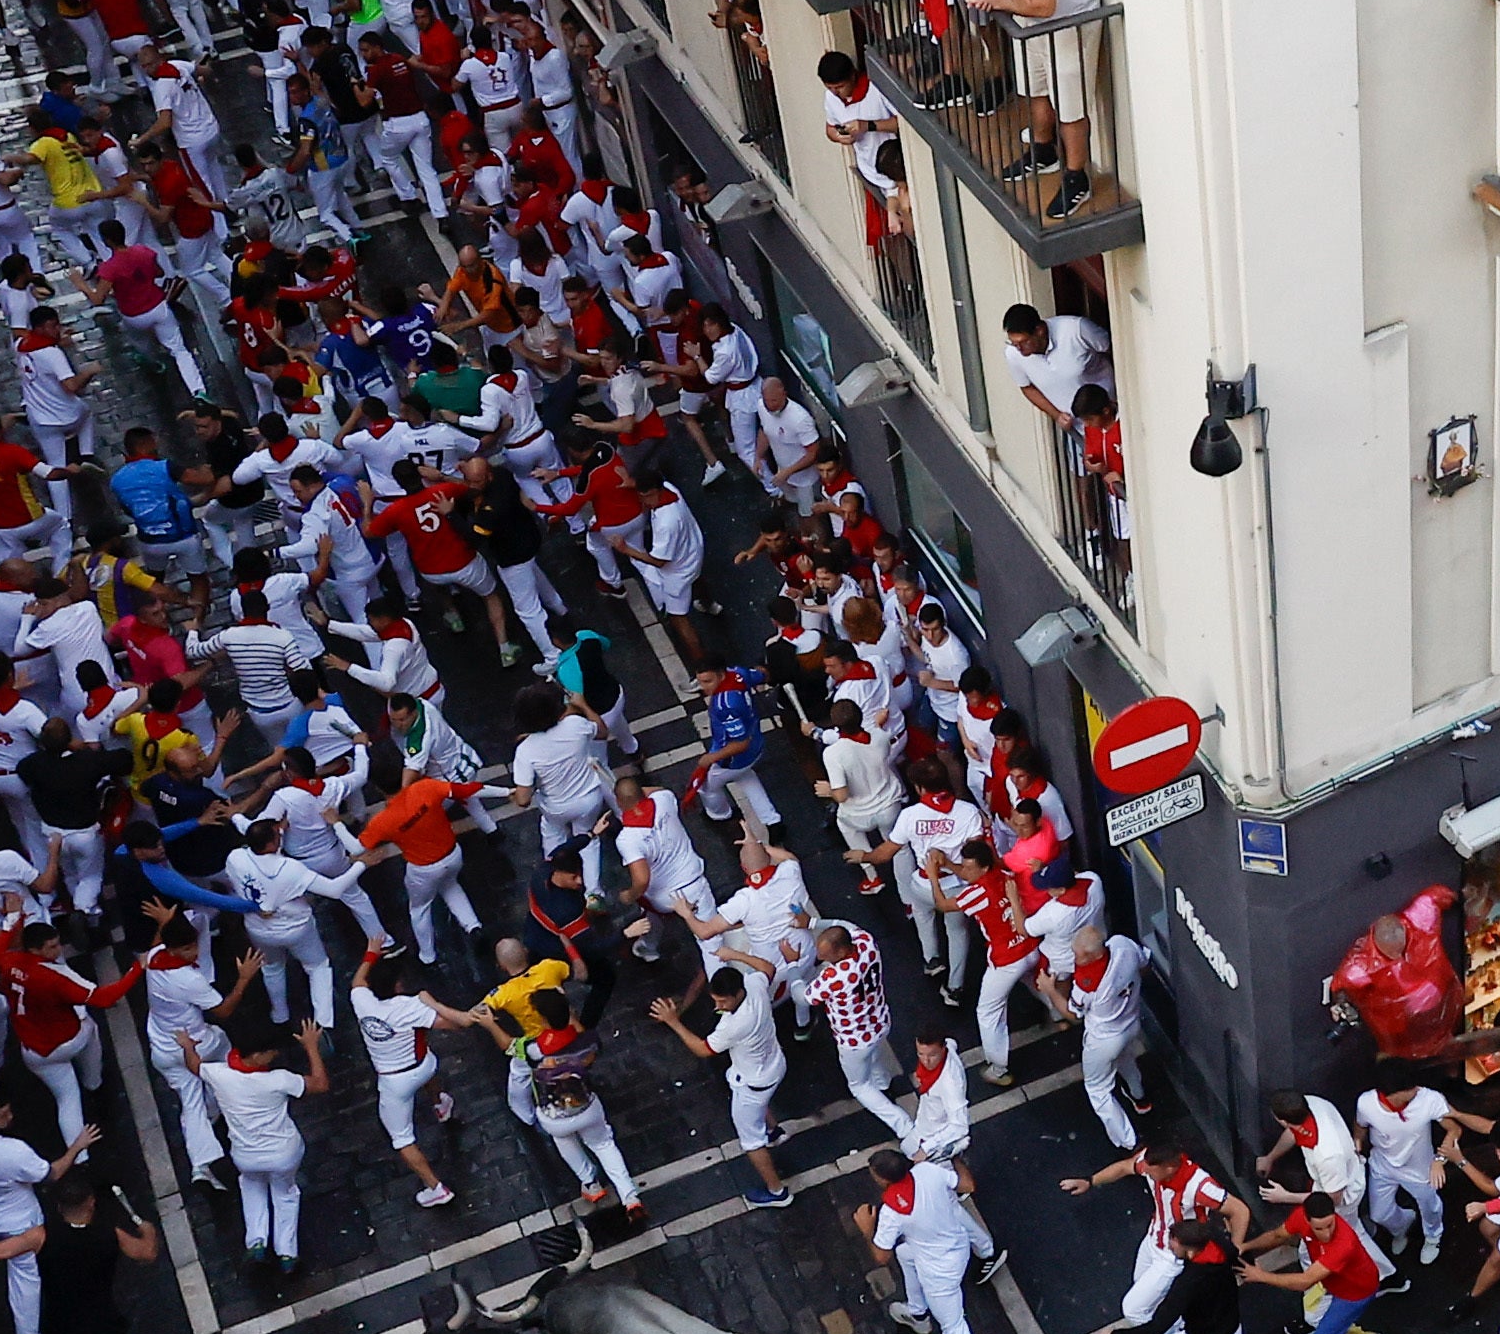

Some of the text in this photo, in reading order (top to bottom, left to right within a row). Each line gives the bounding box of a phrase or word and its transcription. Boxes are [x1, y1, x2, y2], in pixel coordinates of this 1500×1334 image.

[260, 193, 286, 225] 12
[408, 329, 432, 356] 9
[414, 502, 440, 533] 5
[142, 739, 159, 770] 9
[1110, 797, 1155, 822] EXCEPTO
[1110, 806, 1159, 832] BICICLETAS
[1113, 818, 1159, 846] BIZIKLETAK
[11, 982, 26, 1016] 7
